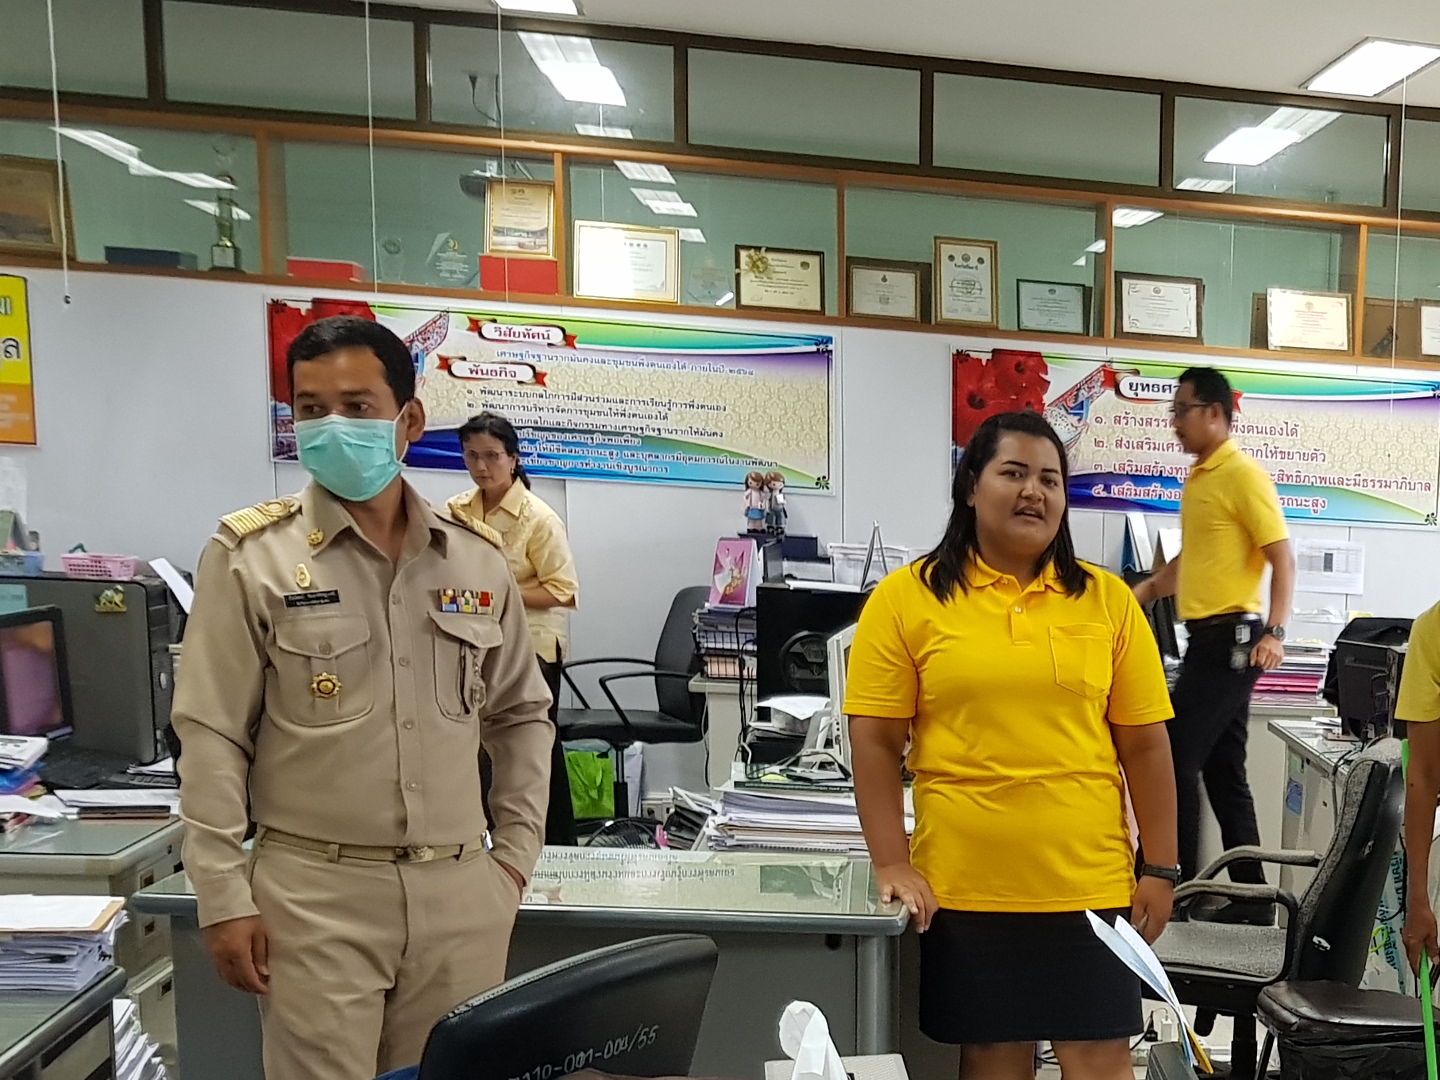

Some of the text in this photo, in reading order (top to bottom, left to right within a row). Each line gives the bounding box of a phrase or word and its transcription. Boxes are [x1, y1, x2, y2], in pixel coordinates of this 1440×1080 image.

[493, 325, 551, 341] วิสัยทัศน์
[467, 363, 517, 379] พันธกิจ
[1128, 381, 1179, 398] ยุทธศา
[1114, 435, 1184, 453] ส่งเสริมเศร
[1238, 443, 1326, 463] รากให้ขยายตัว
[1270, 468, 1432, 493] ะสิทธิภาพและมีธรรมาภิบาล
[1112, 482, 1183, 500] เสริมสร้างอ
